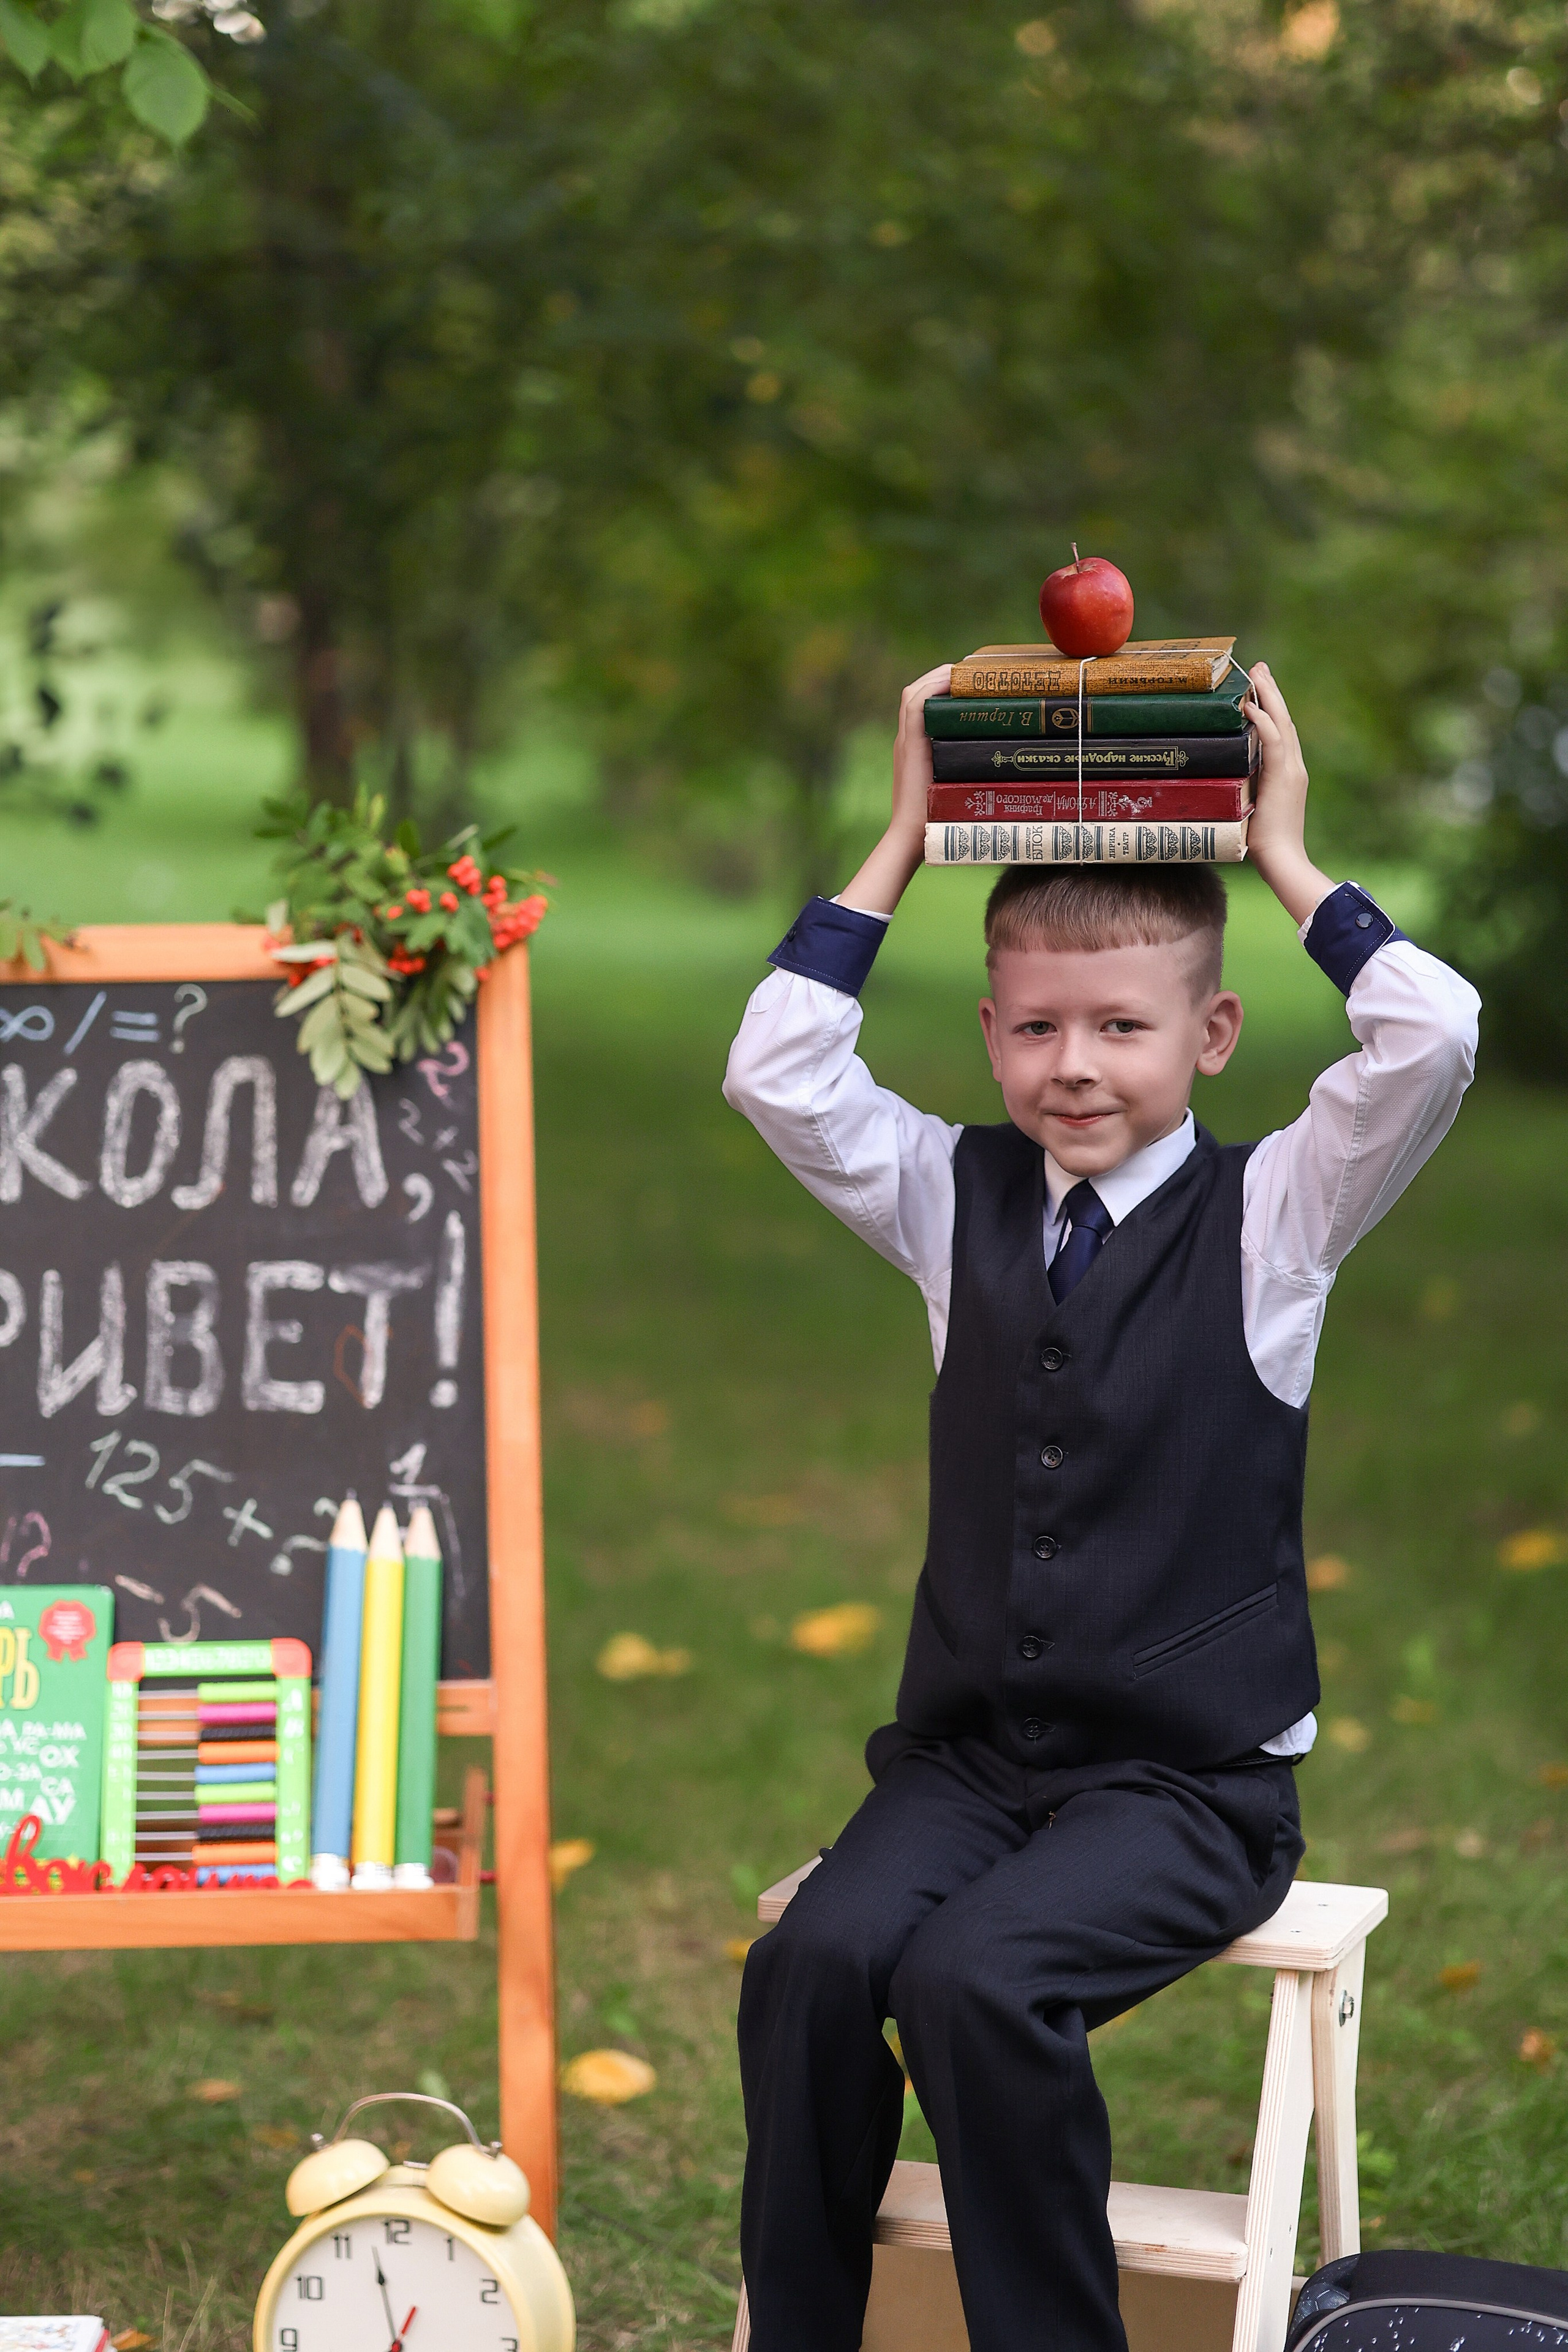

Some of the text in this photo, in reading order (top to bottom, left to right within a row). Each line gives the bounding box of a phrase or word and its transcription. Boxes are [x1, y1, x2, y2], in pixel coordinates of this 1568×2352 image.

[973, 671, 1061, 692] ДЕТСТВО
[959, 707, 1034, 726] В. Гаршин
[1017, 751, 1175, 766] Русские народные сказки
[1003, 803, 1044, 815] Графиня
[1032, 826, 1043, 861] БЛОК
[383, 2218, 411, 2245] 12
[333, 2234, 352, 2259] 11
[295, 2274, 325, 2301] 10
[480, 2278, 500, 2304] 2
[279, 2327, 299, 2352] 9
